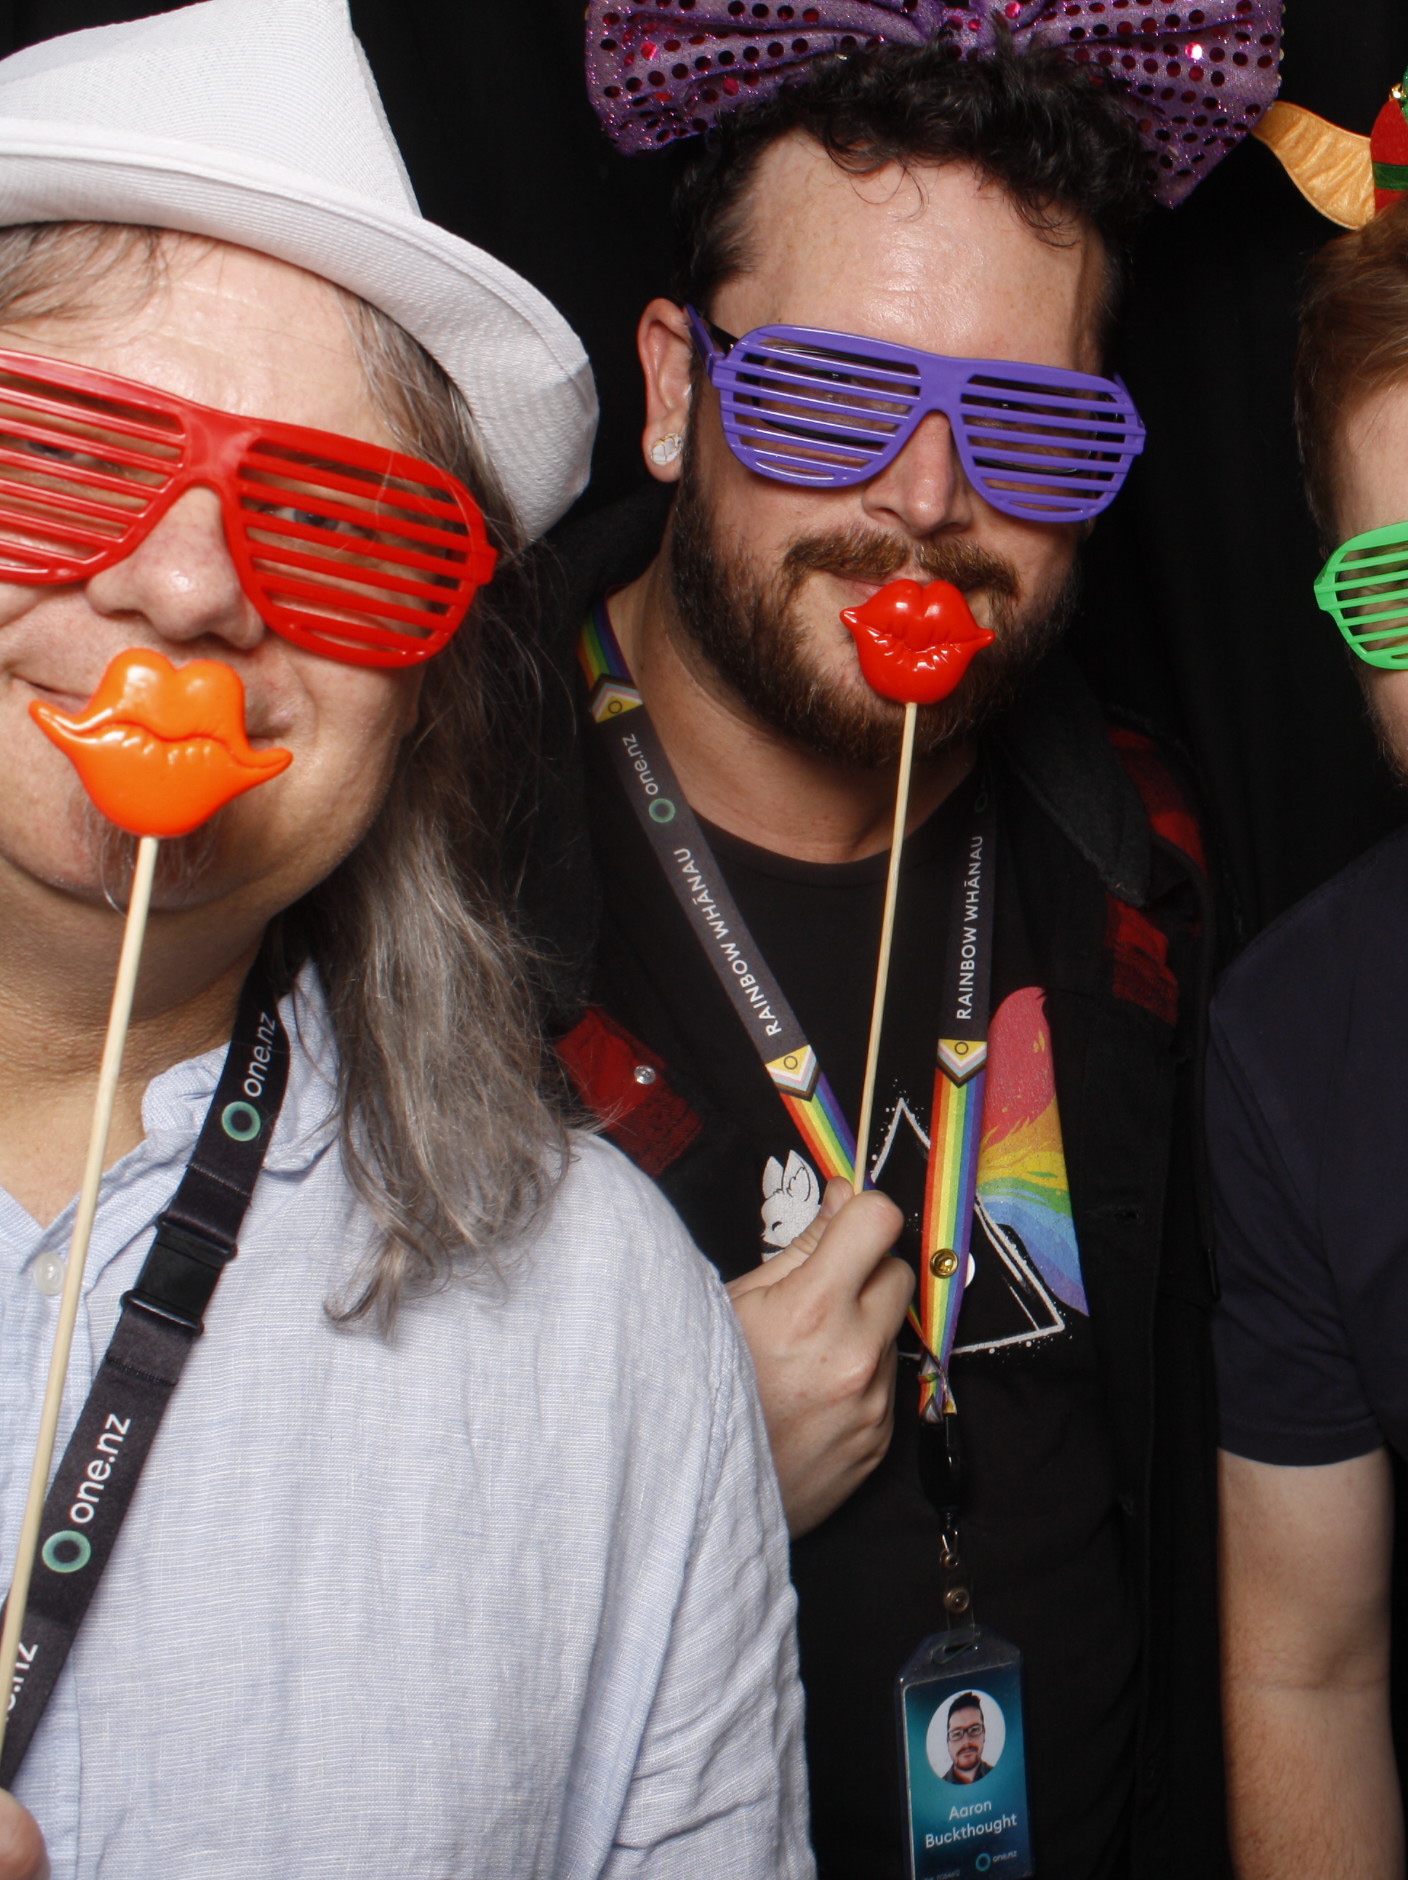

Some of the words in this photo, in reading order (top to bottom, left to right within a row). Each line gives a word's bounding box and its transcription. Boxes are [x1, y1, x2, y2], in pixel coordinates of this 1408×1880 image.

[622, 733, 659, 797] one.nz
[674, 848, 730, 940] WHĀNAU
[963, 836, 983, 923] WHĀNAU
[721, 942, 782, 1037] RAINBOW
[956, 926, 978, 1020] RAINBOW
[243, 1011, 278, 1098] one.nz
[69, 1413, 131, 1524] one.nz
[925, 1813, 1018, 1849] Buckthought
[949, 1800, 992, 1821] Aaron
